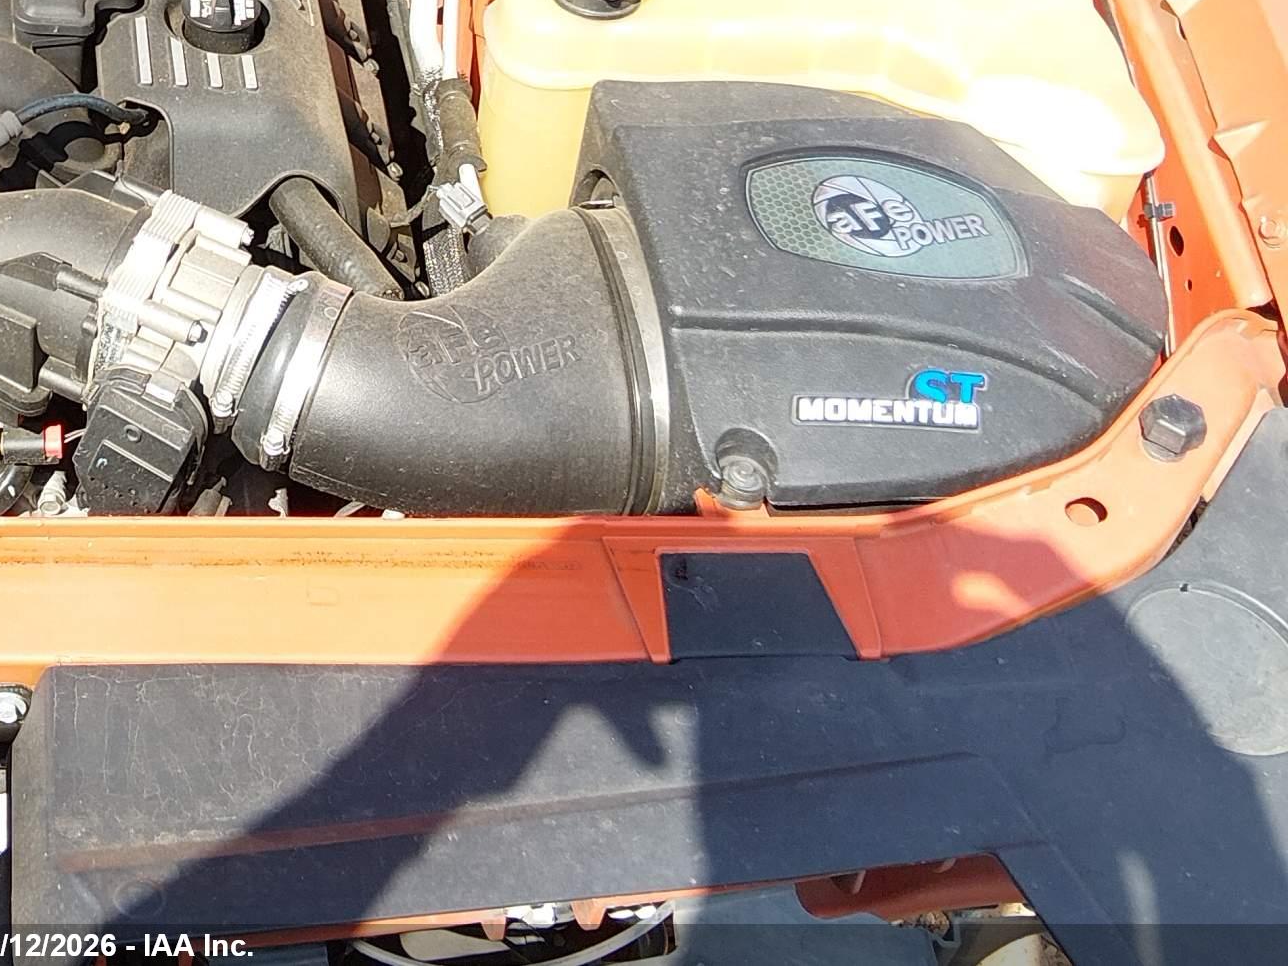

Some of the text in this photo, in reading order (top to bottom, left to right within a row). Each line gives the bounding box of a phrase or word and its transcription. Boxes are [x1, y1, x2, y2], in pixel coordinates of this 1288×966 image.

[894, 213, 990, 251] POWER
[472, 333, 580, 395] POWER
[914, 367, 986, 404] ST
[798, 396, 978, 427] MOMENTUM
